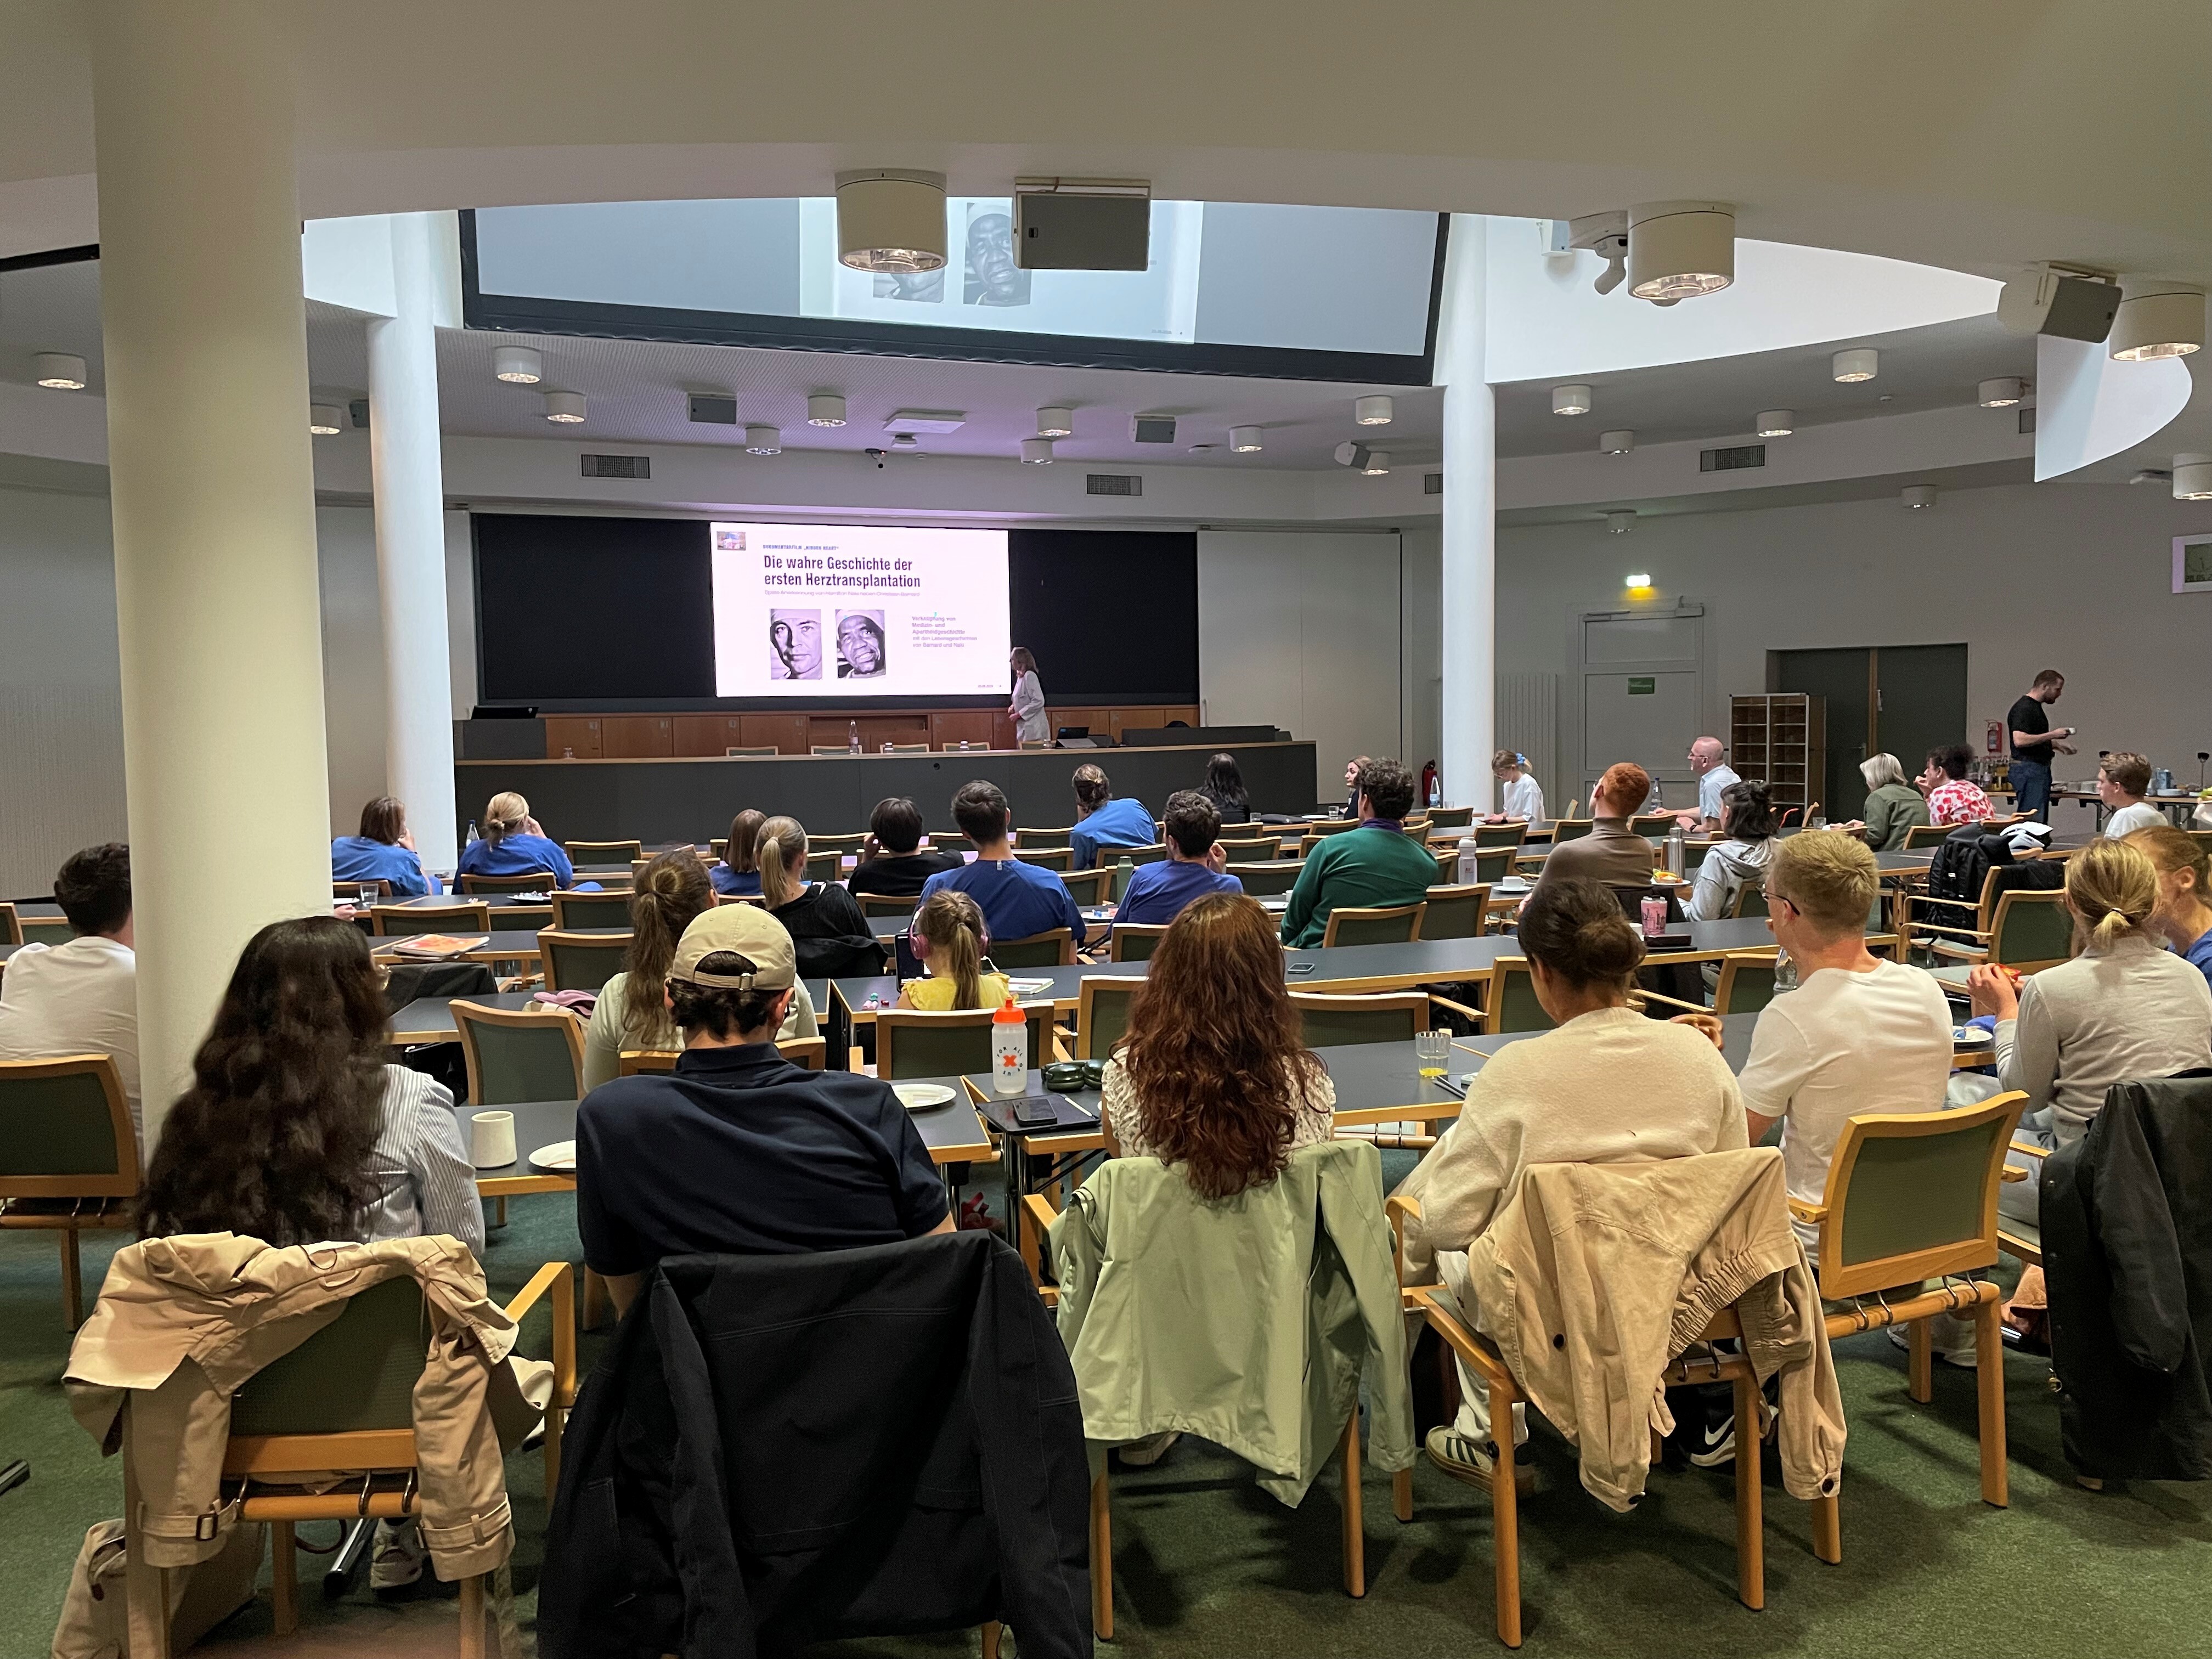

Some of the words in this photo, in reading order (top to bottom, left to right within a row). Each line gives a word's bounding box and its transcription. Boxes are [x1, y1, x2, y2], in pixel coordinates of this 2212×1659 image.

[764, 555, 782, 568] Die
[786, 556, 823, 569] wahre
[827, 557, 890, 570] Geschichte
[894, 558, 913, 571] der
[764, 573, 802, 585] ersten
[806, 573, 921, 589] Herztransplantation
[997, 1046, 1007, 1057] FOR
[1013, 1047, 1023, 1057] ALL
